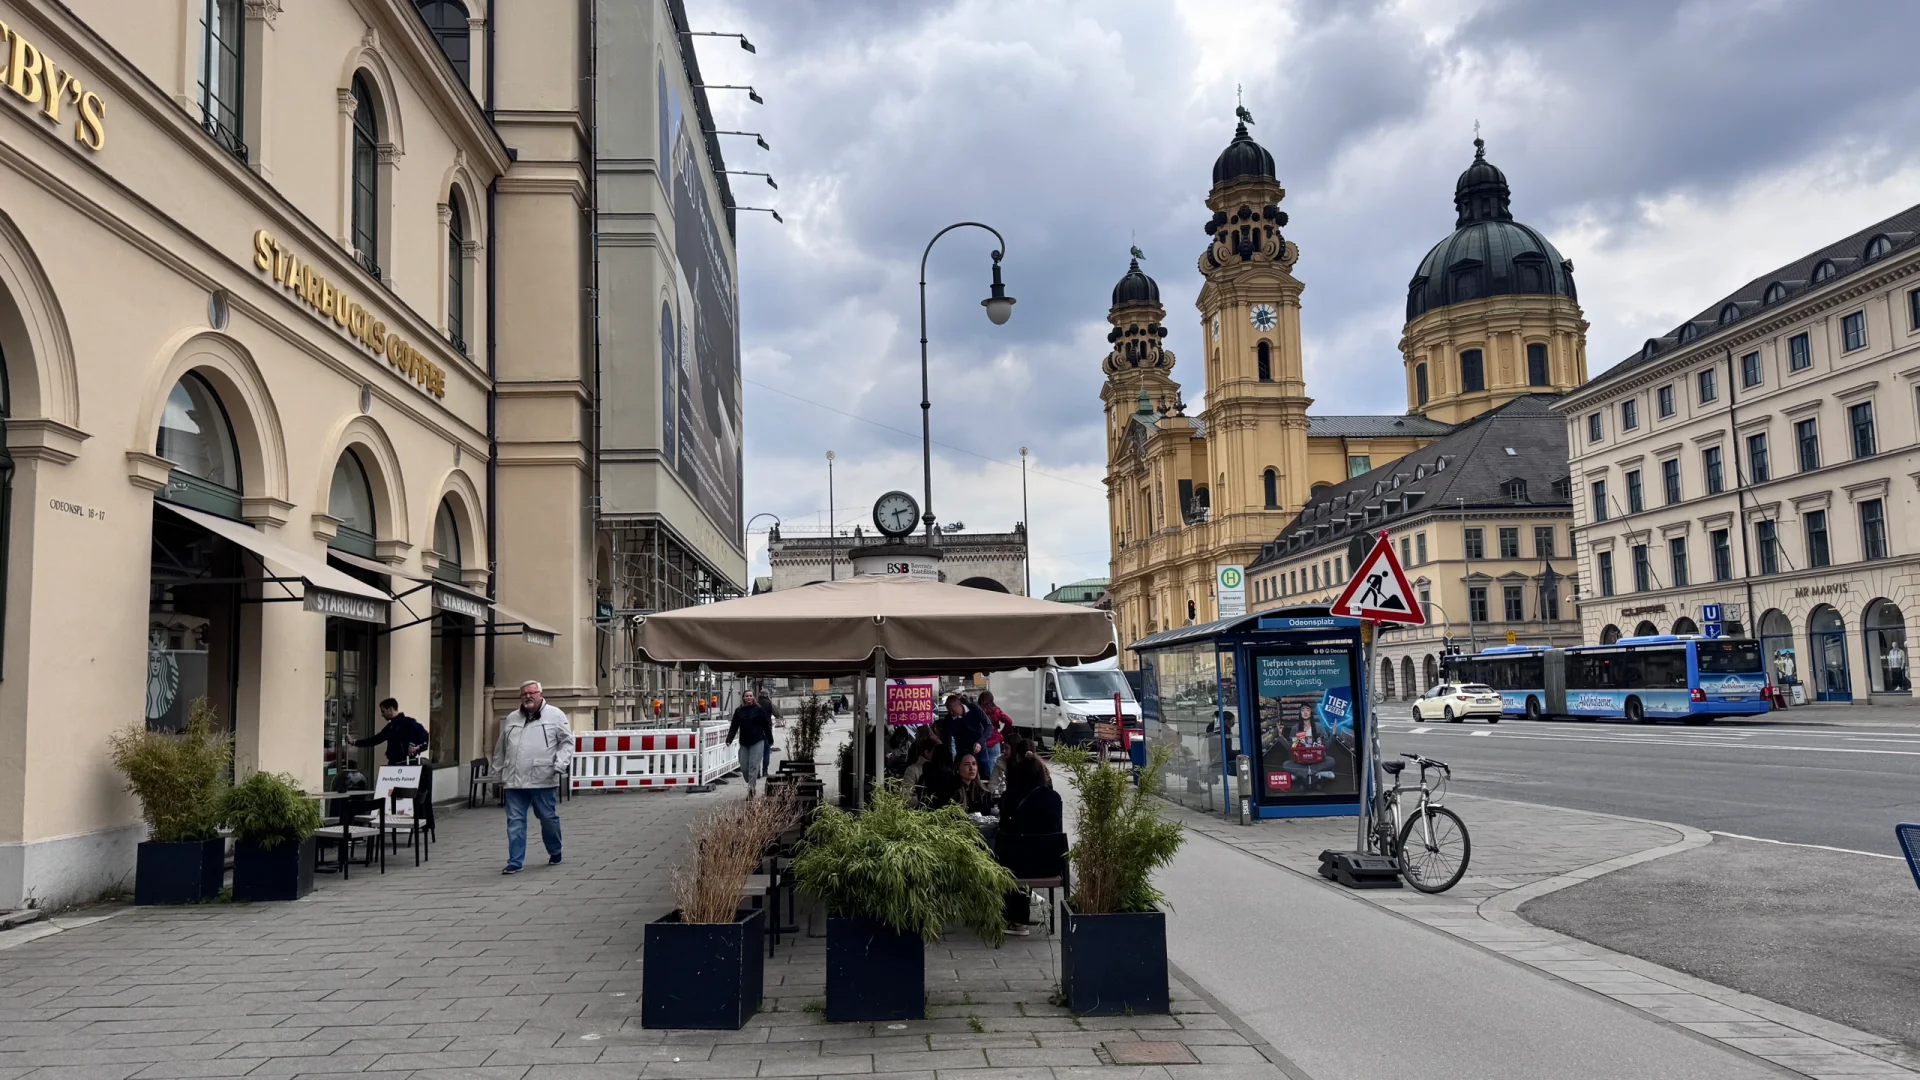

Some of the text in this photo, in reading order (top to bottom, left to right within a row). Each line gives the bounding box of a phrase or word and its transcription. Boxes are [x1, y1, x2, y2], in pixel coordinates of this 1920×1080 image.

[0, 19, 106, 151] BY'S
[253, 229, 447, 400] STARBUCKS COFFEE
[887, 562, 910, 574] BSB
[1795, 582, 1849, 598] MR MARVIS
[316, 593, 375, 619] STARBUCKS
[442, 593, 483, 617] STARBUCKS
[1706, 607, 1717, 620] U
[1288, 618, 1335, 627] Odeonsplatz
[1262, 658, 1336, 668] Tiefpreis-entspannt:
[1262, 667, 1341, 677] 4.000 Produkte immer
[1263, 677, 1324, 687] discount-günstig.
[889, 687, 931, 699] FARBEN
[889, 700, 931, 712] JAPANS
[1328, 695, 1348, 709] TIEF
